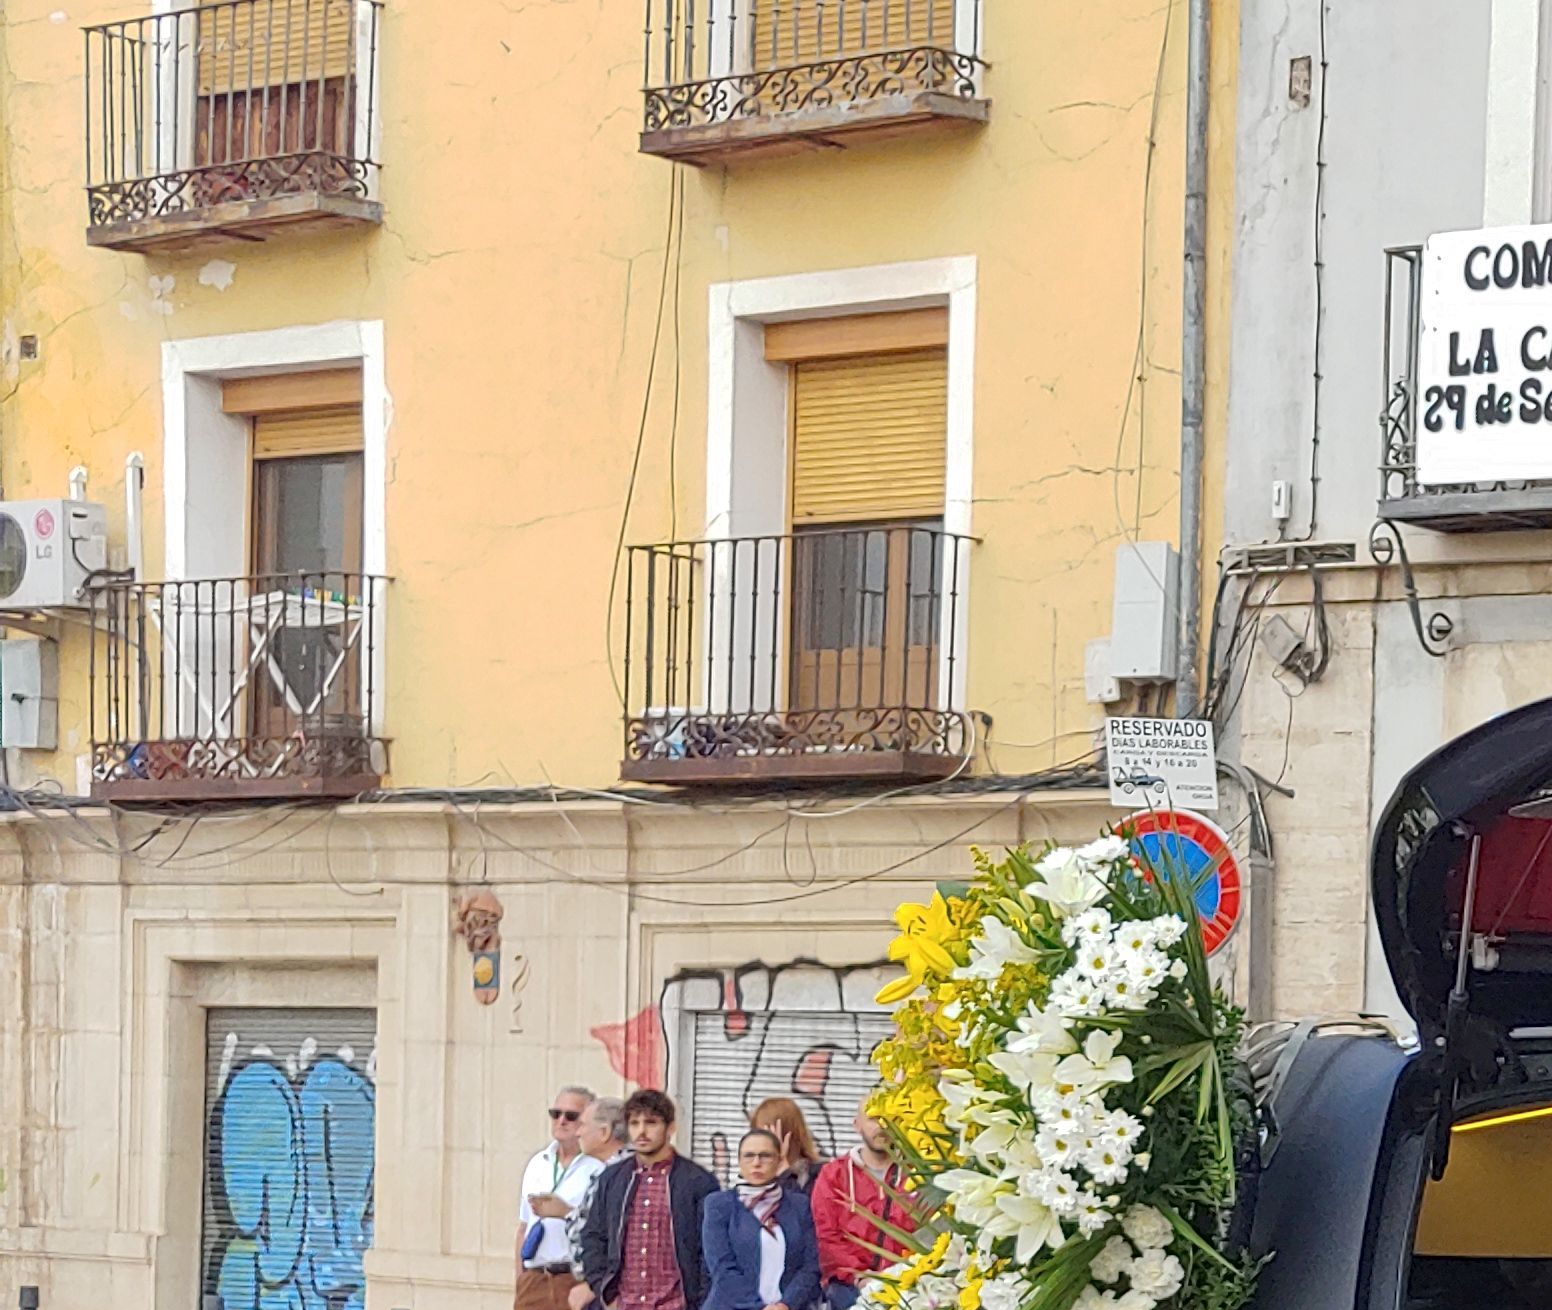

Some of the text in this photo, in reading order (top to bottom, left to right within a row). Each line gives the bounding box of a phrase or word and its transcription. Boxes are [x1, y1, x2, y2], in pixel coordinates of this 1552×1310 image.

[1448, 327, 1499, 377] LA
[1425, 383, 1466, 433] 29
[1474, 378, 1513, 426] de
[36, 545, 53, 560] LG
[1110, 719, 1207, 738] RESERVADO
[1139, 738, 1208, 750] LABORABLES
